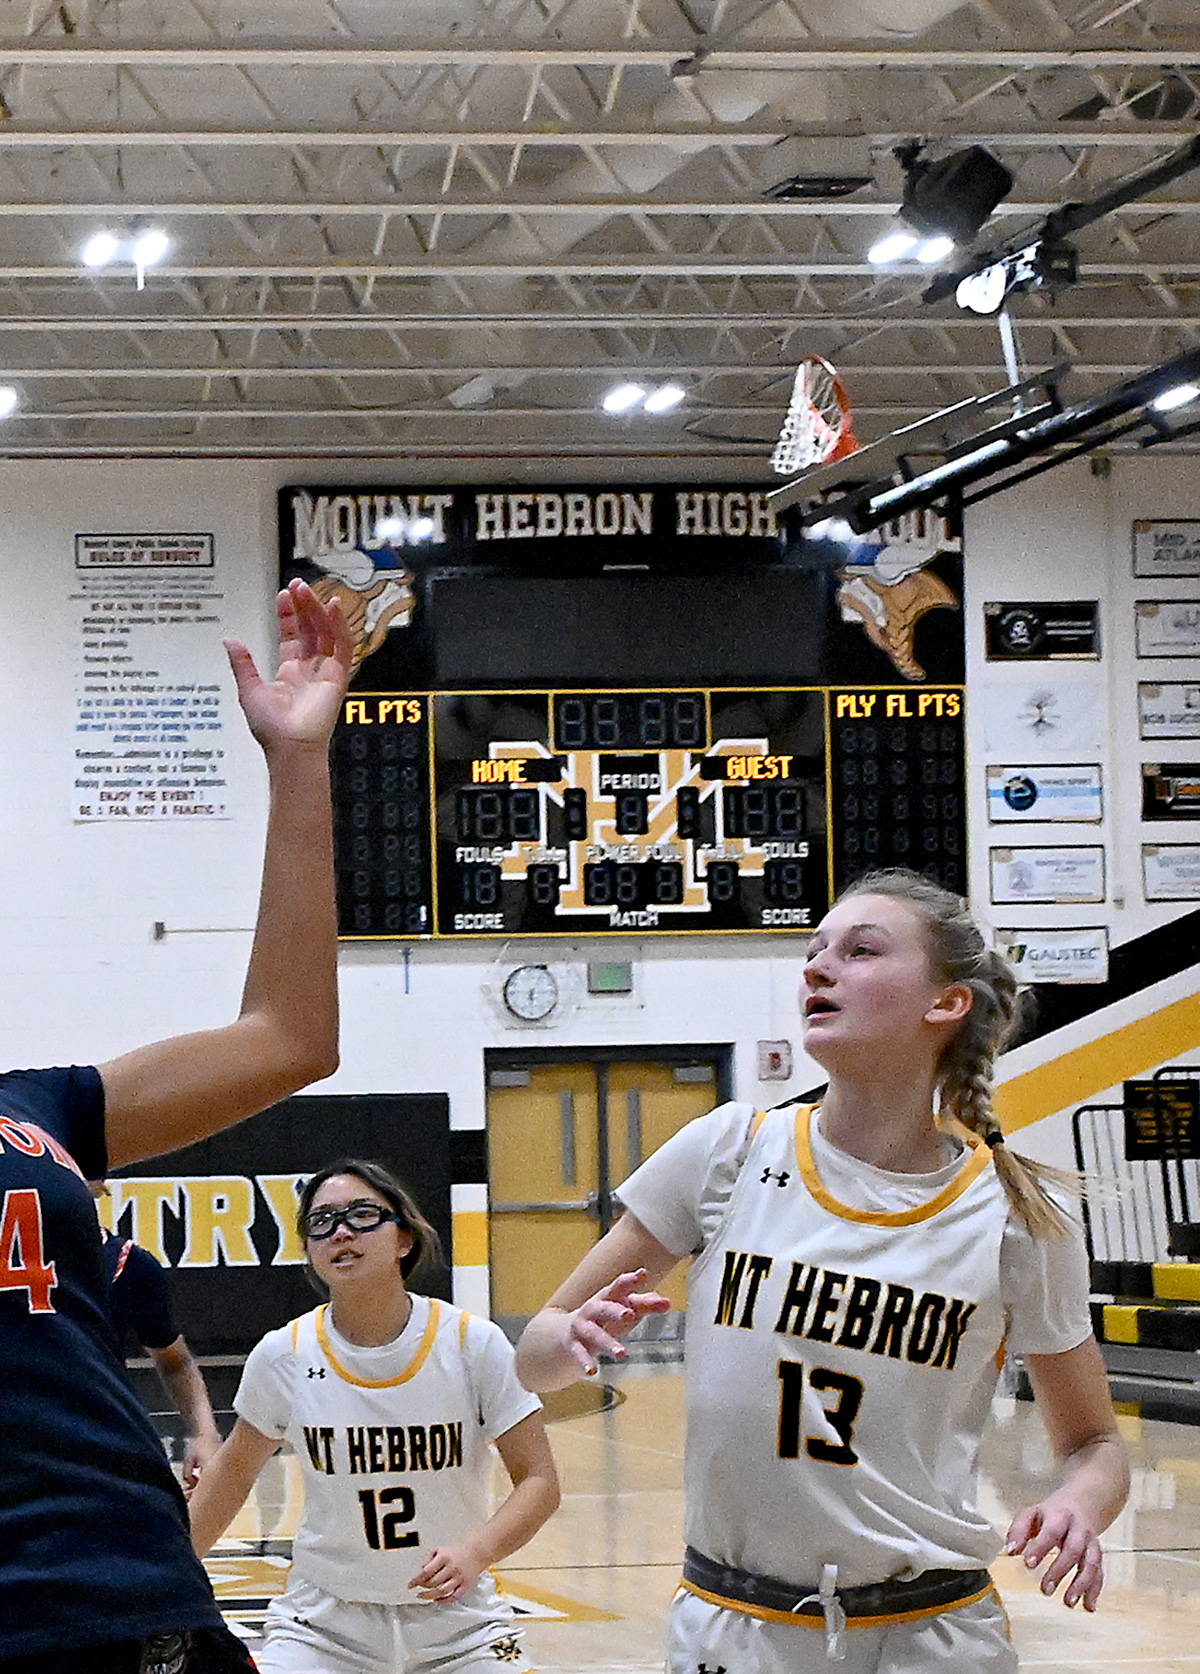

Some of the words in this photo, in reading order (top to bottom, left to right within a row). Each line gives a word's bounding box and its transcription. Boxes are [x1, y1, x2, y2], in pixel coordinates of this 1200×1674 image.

[292, 494, 453, 559] MOUNT
[475, 491, 653, 541] HEBRON
[676, 492, 781, 537] HIGH
[346, 701, 373, 724] FL
[378, 700, 422, 724] PTS
[836, 694, 877, 718] PLY
[885, 694, 913, 717] FL
[918, 693, 961, 717] PTS
[471, 759, 528, 783] HOME
[726, 756, 794, 779] GUEST
[602, 774, 660, 789] PERIOD
[137, 790, 157, 801] THE
[455, 847, 503, 864] FOULS
[762, 842, 810, 859] FOULS
[454, 914, 504, 930] SCORE
[610, 911, 660, 927] MATCH
[761, 909, 812, 925] SCORE
[713, 1249, 774, 1331] MT
[773, 1260, 979, 1371] HEBRON
[776, 1358, 866, 1468] 13
[346, 1421, 463, 1475] HEBRON
[358, 1486, 421, 1551] 12
